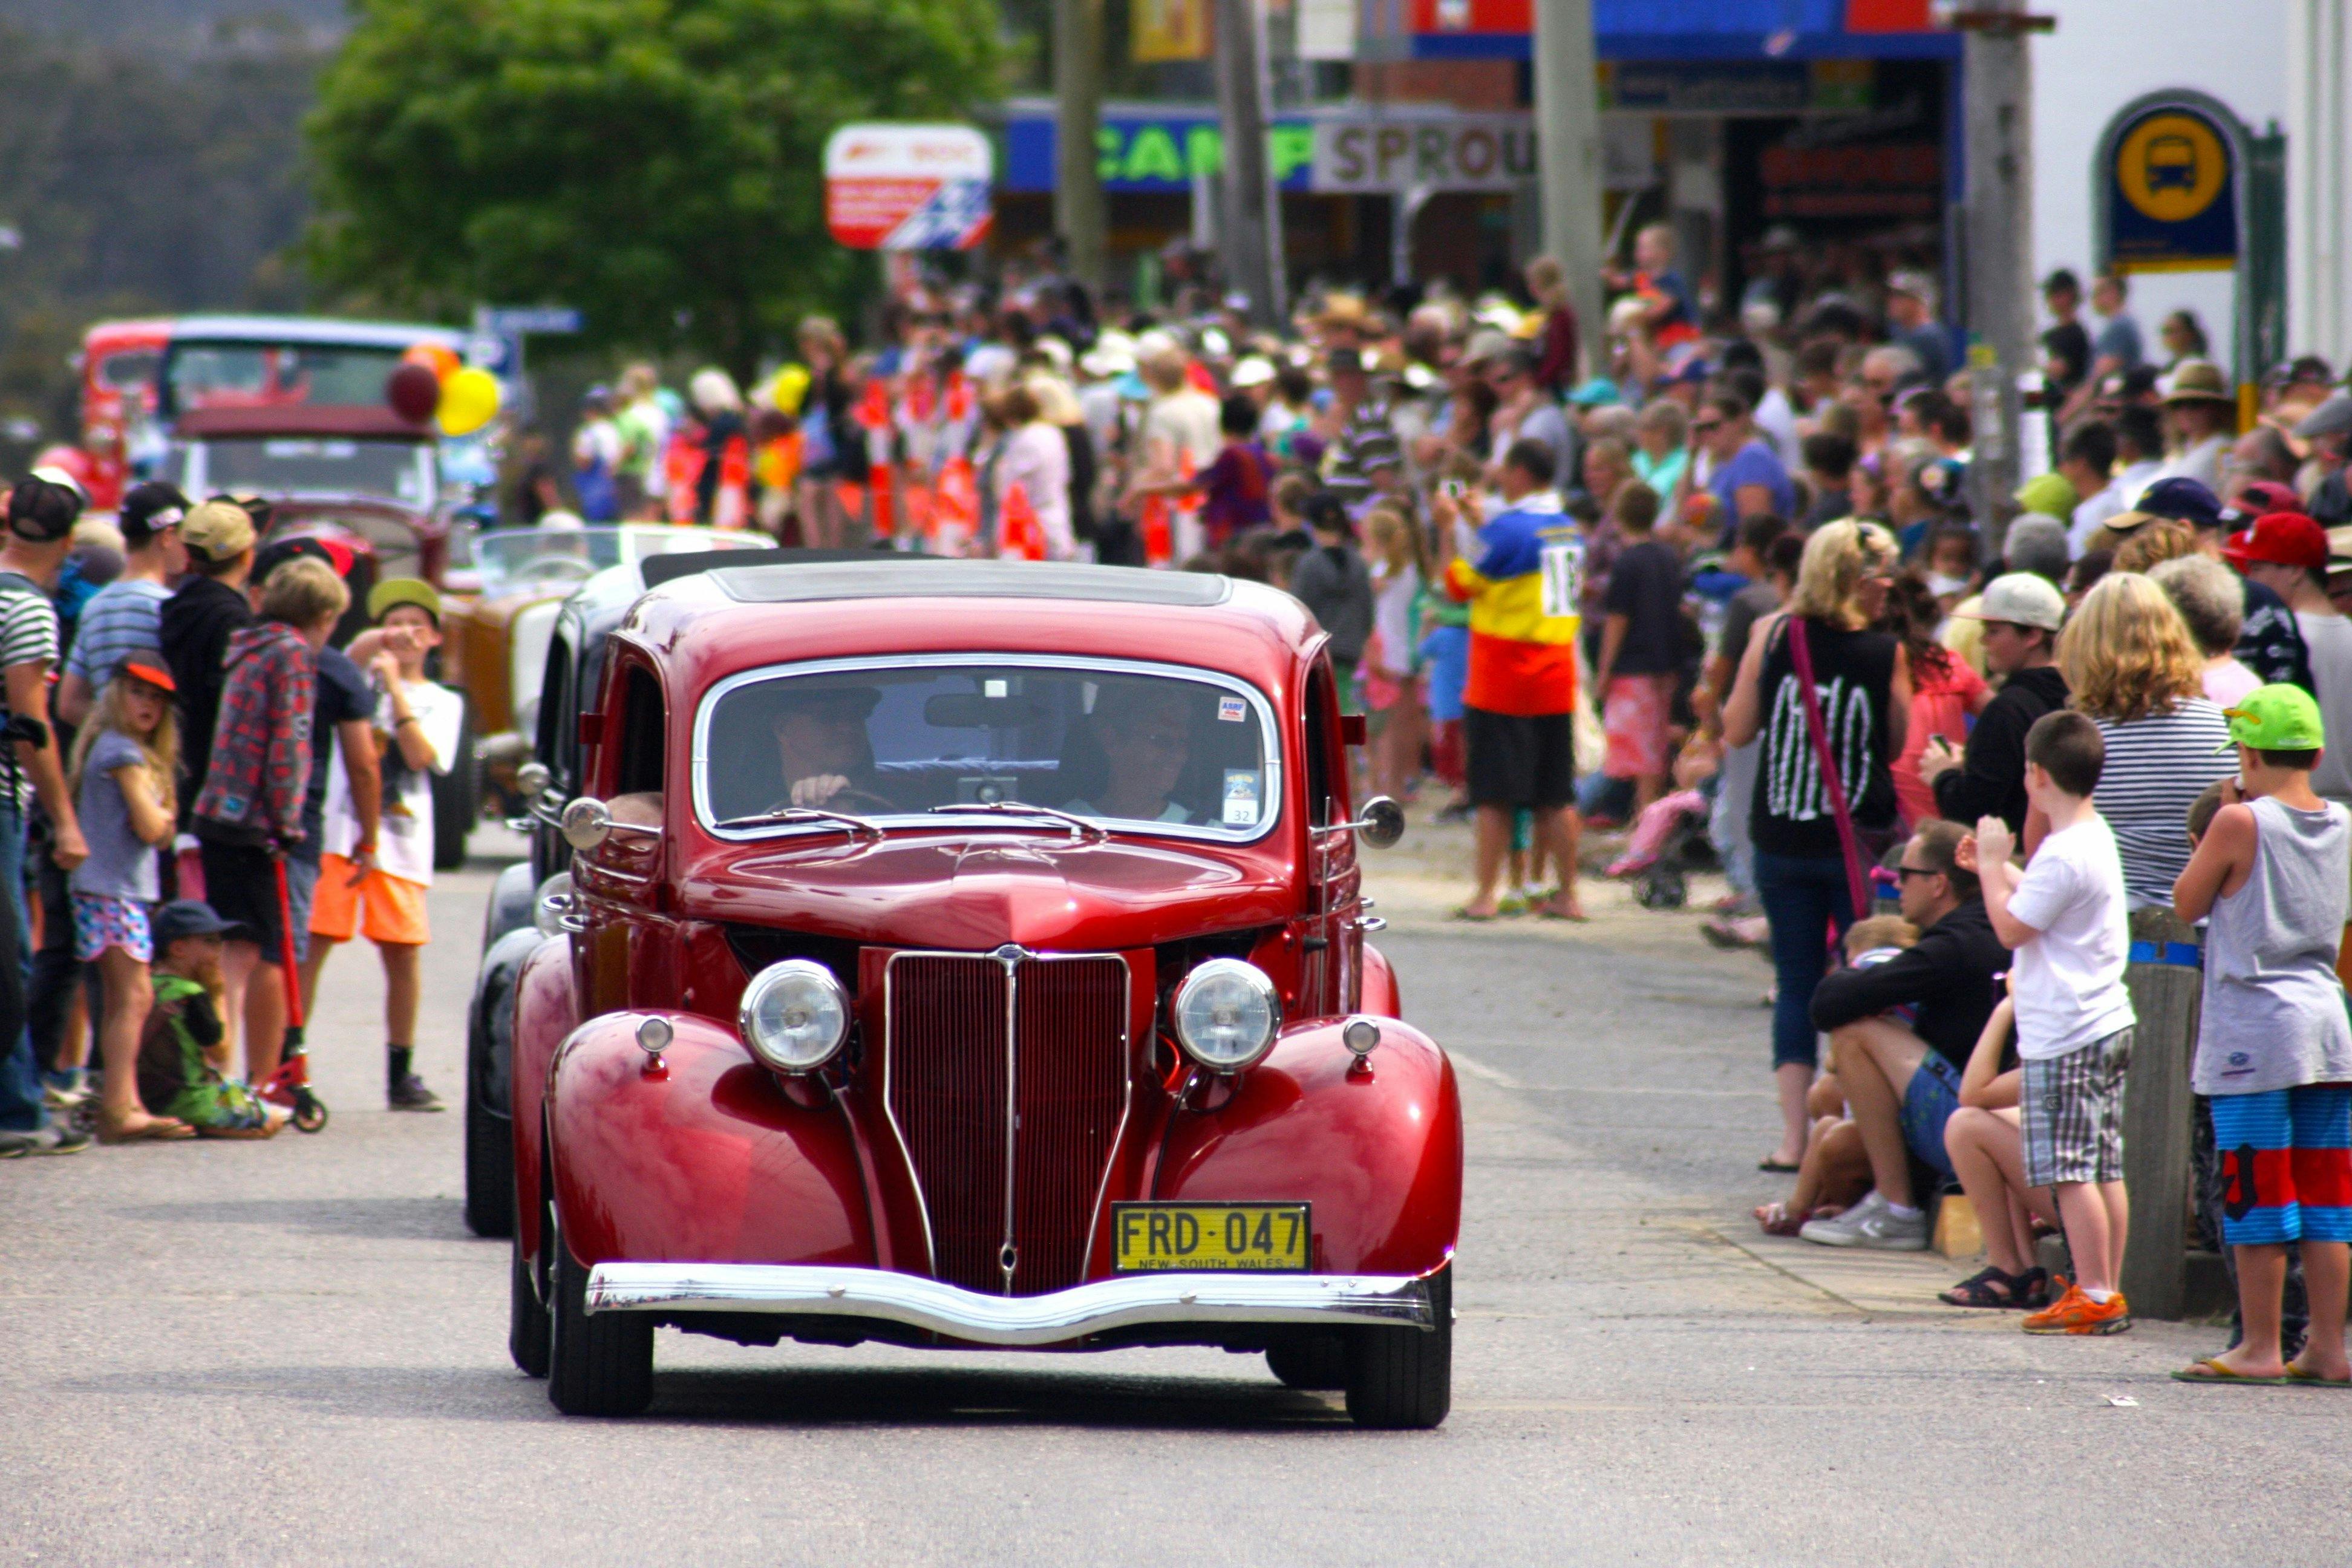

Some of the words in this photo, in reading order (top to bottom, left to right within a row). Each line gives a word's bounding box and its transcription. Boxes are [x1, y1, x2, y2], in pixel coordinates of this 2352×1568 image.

[1333, 126, 1537, 181] SPROU
[1234, 810, 1249, 822] 32
[1139, 1259, 1169, 1269] NEW
[1180, 1259, 1227, 1269] SOUTH
[1236, 1258, 1284, 1269] WALES
